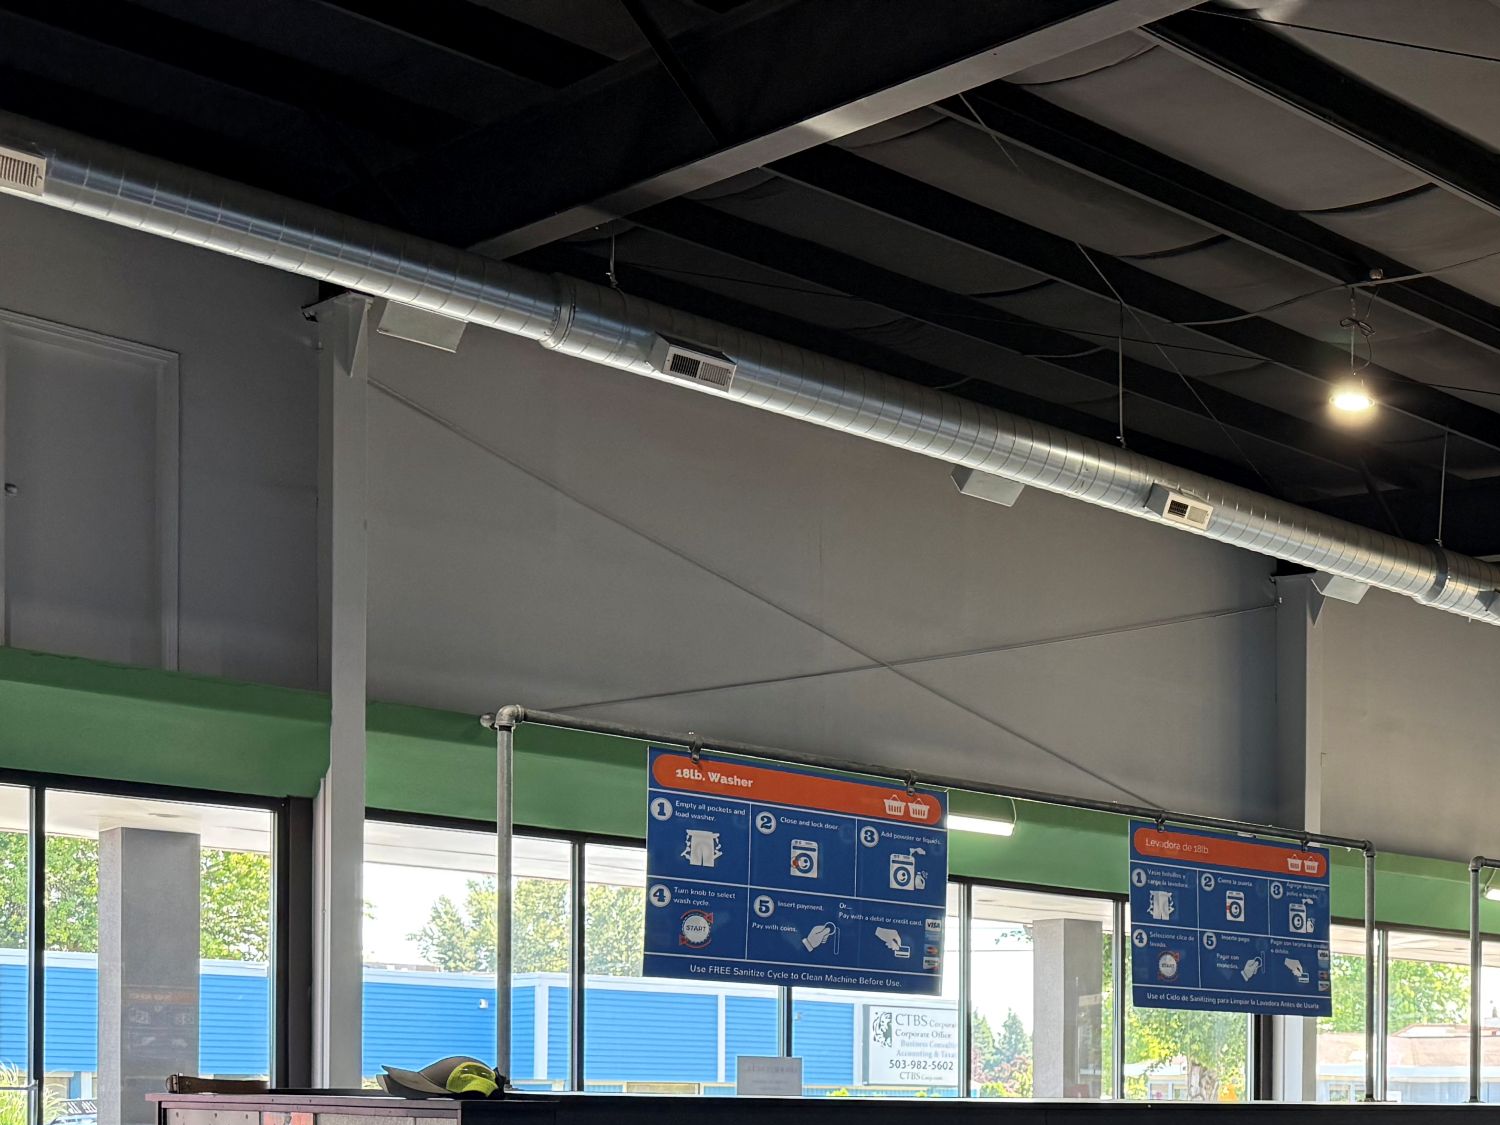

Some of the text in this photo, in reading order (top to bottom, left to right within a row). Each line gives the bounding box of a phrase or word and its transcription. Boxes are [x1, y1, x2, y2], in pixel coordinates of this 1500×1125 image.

[675, 768, 753, 788] 18lb. Washer
[657, 802, 667, 817] 1
[675, 800, 696, 810] Empty
[707, 805, 732, 814] pockets
[760, 815, 772, 830] 2
[780, 816, 797, 825] Close
[799, 819, 810, 827] and
[811, 820, 824, 829] lock
[863, 829, 876, 844] 3
[881, 831, 893, 839] Add
[893, 833, 914, 841] powder
[653, 888, 667, 903] 4
[690, 888, 707, 897] knob
[716, 891, 736, 899] select
[758, 899, 770, 914] 5
[777, 901, 795, 909] Insert
[765, 923, 779, 931] with
[690, 964, 902, 987] Use FREE Sanitize Cycle to Clean Machine Before Use.
[1166, 993, 1180, 1001] Ciclo
[1230, 998, 1250, 1006] Limpiar
[1256, 999, 1280, 1007] Lavadora
[1281, 999, 1295, 1008] Antes
[895, 1013, 928, 1027] CTBS
[895, 1029, 952, 1039] Corporate Office
[896, 1050, 932, 1059] Accounting
[889, 1059, 954, 1071] 503-982-5602
[899, 1072, 921, 1081] CTBS
